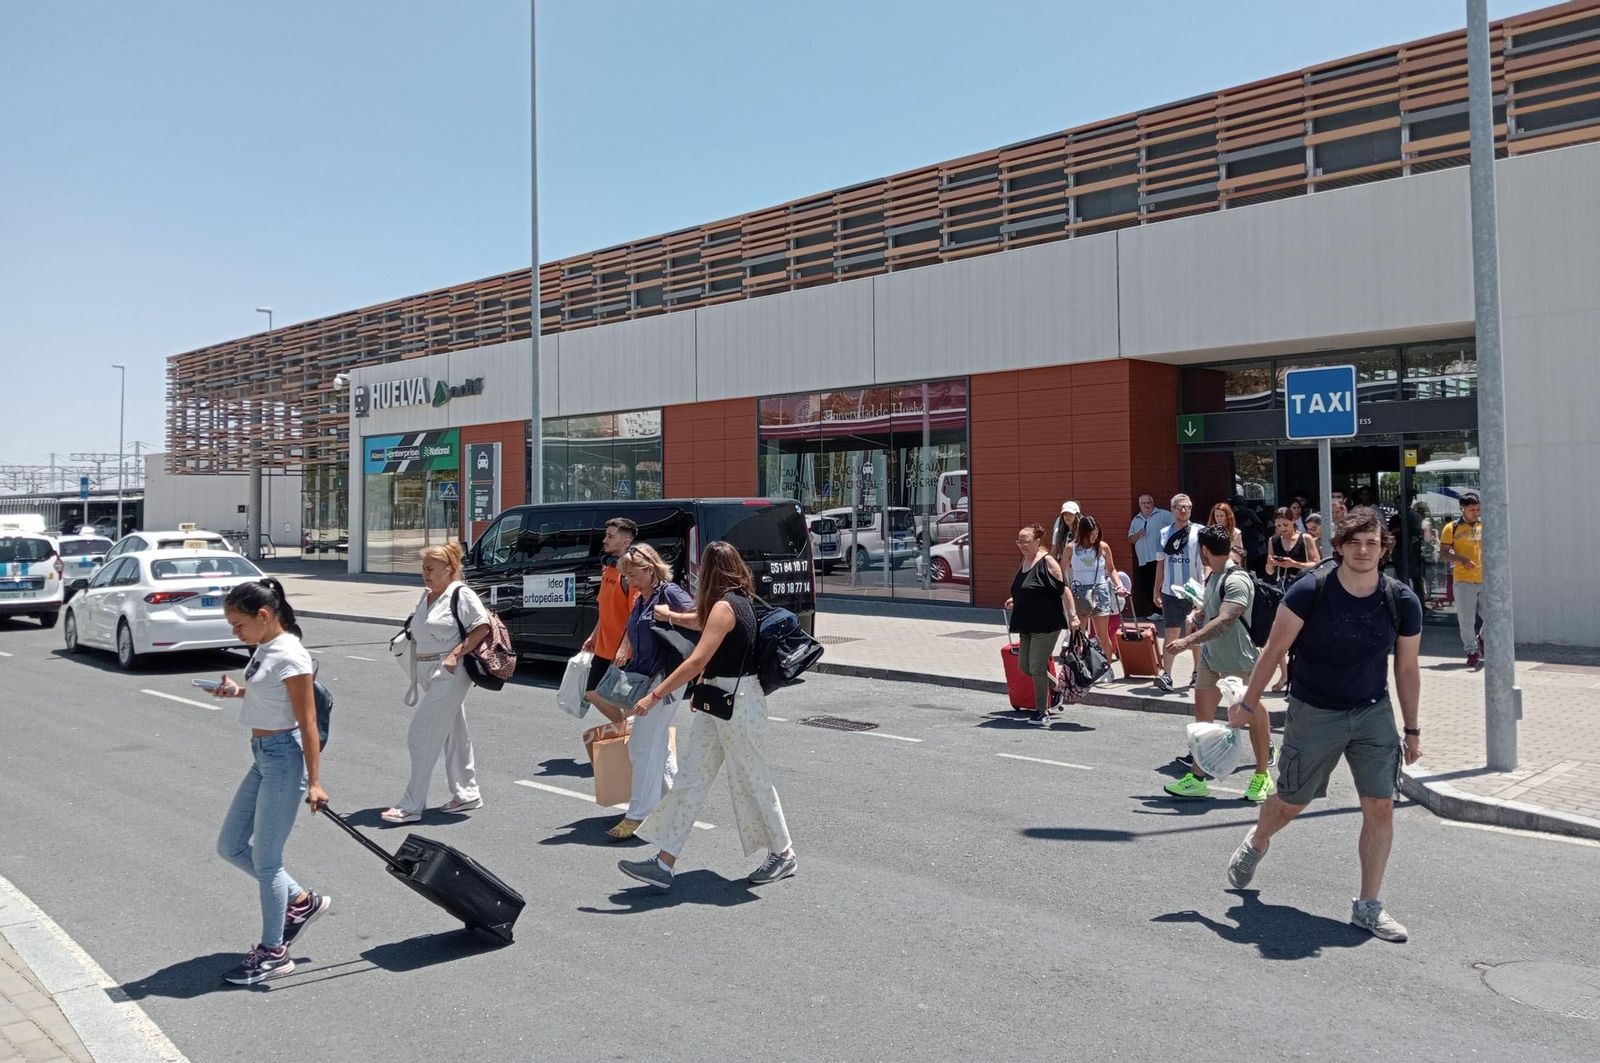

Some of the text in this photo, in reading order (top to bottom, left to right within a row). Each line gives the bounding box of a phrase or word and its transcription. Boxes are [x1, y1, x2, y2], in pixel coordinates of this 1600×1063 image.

[371, 376, 427, 409] HUELVA
[1290, 391, 1351, 414] TAXI
[387, 448, 419, 459] enterprise
[919, 476, 956, 487] CRISAL
[770, 560, 808, 574] 651 84 10 17
[547, 578, 564, 589] ideo
[772, 581, 810, 595] 678 18 77 14
[524, 592, 564, 605] ortopedias
